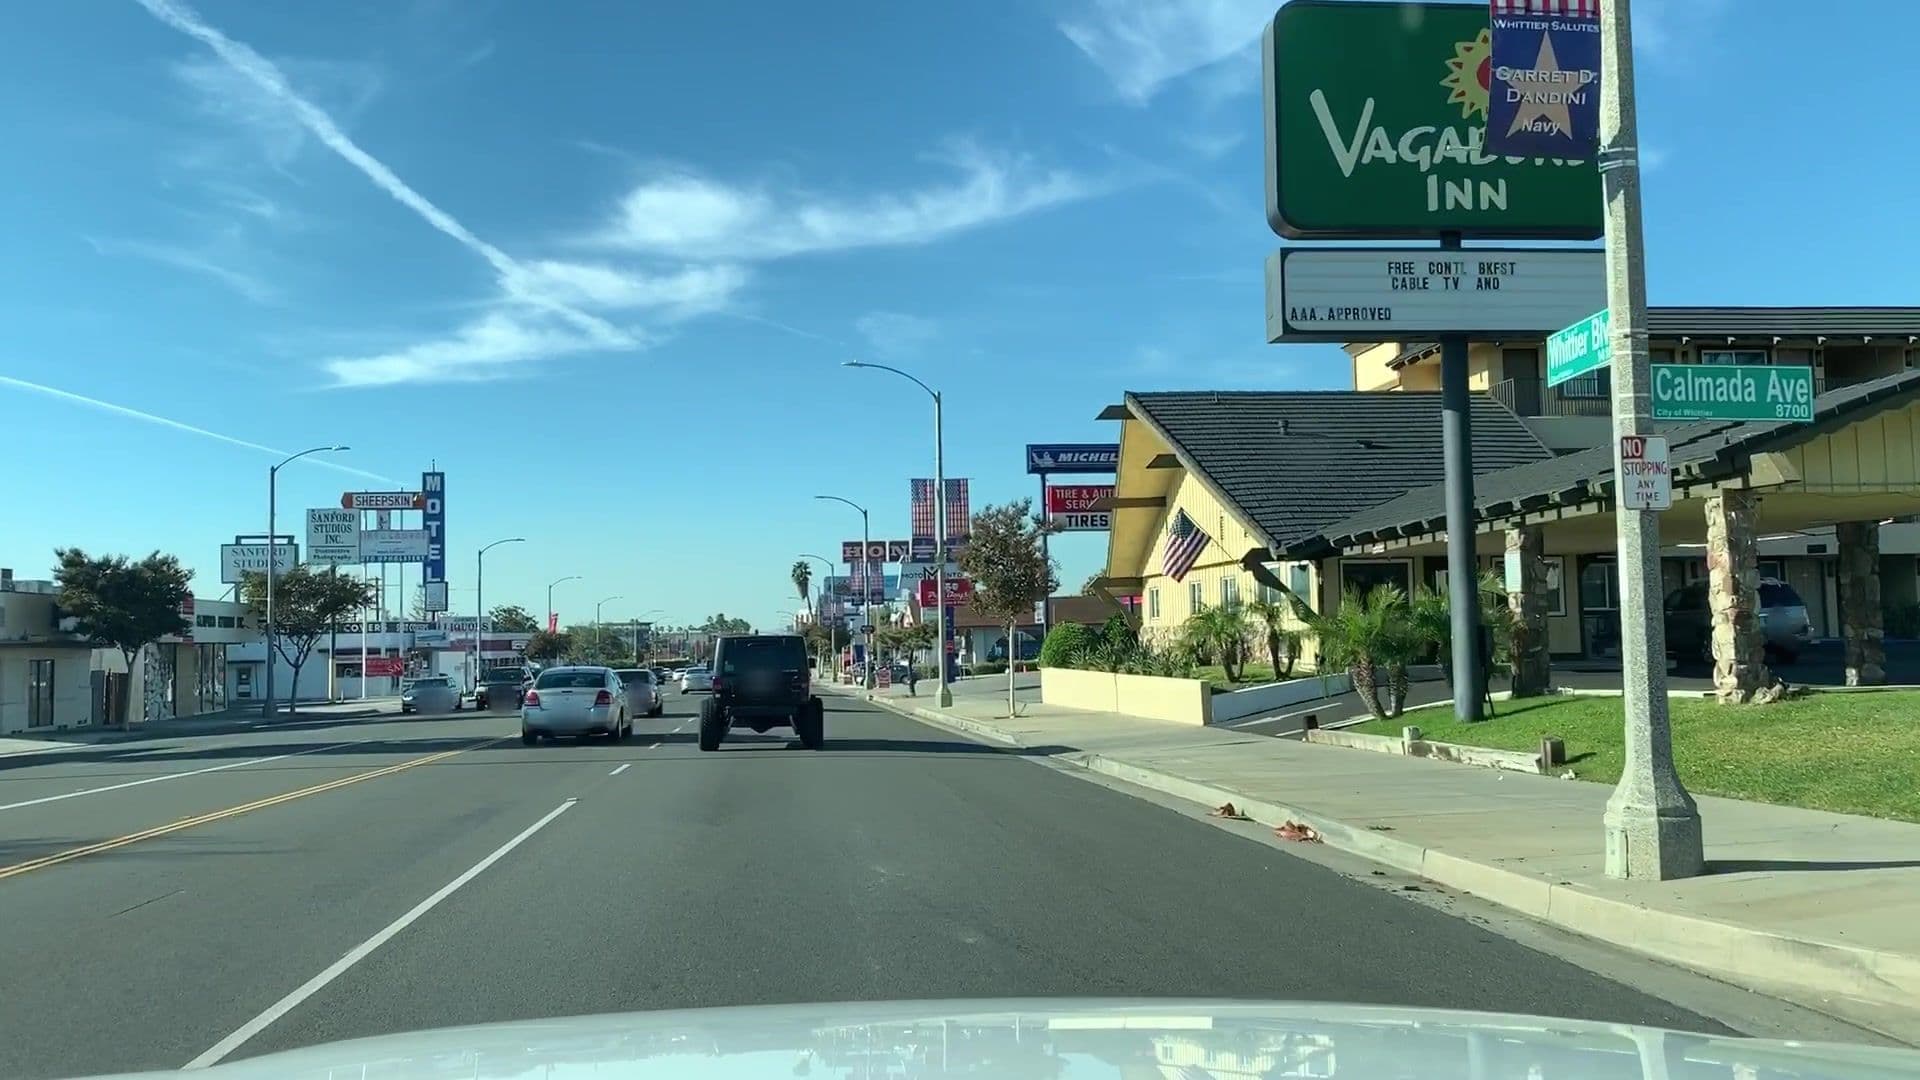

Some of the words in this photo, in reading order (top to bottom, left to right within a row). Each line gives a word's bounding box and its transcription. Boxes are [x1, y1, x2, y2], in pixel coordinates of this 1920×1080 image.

[1495, 66, 1572, 83] GARRET
[1506, 88, 1586, 105] DANDINI
[1310, 88, 1585, 178] VAGAB
[1521, 119, 1560, 136] Navy
[1427, 174, 1507, 211] INN
[1388, 262, 1415, 275] FREE
[1478, 262, 1517, 275] BKFST
[1391, 277, 1429, 290] CABLE
[1444, 277, 1460, 290] TV
[1549, 327, 1589, 370] Whittier
[1591, 315, 1609, 352] Blv
[1656, 368, 1756, 402] Calmada
[1766, 370, 1809, 403] Ave
[1775, 404, 1809, 418] 8700
[1622, 438, 1643, 457] NO
[1057, 452, 1118, 462] MICHEL
[1624, 461, 1667, 475] STOPPING
[1637, 480, 1655, 489] ANY
[1055, 489, 1078, 499] TIRE
[1092, 489, 1113, 499] AUT
[1635, 492, 1660, 501] TIME
[355, 495, 411, 507] SHEEPSKIN
[311, 513, 355, 523] SANFORD
[1066, 514, 1109, 527] TIRES
[313, 523, 352, 534] STUDIOS
[425, 474, 442, 582] MOTEL
[324, 534, 344, 545] INC.
[842, 545, 908, 558] HON
